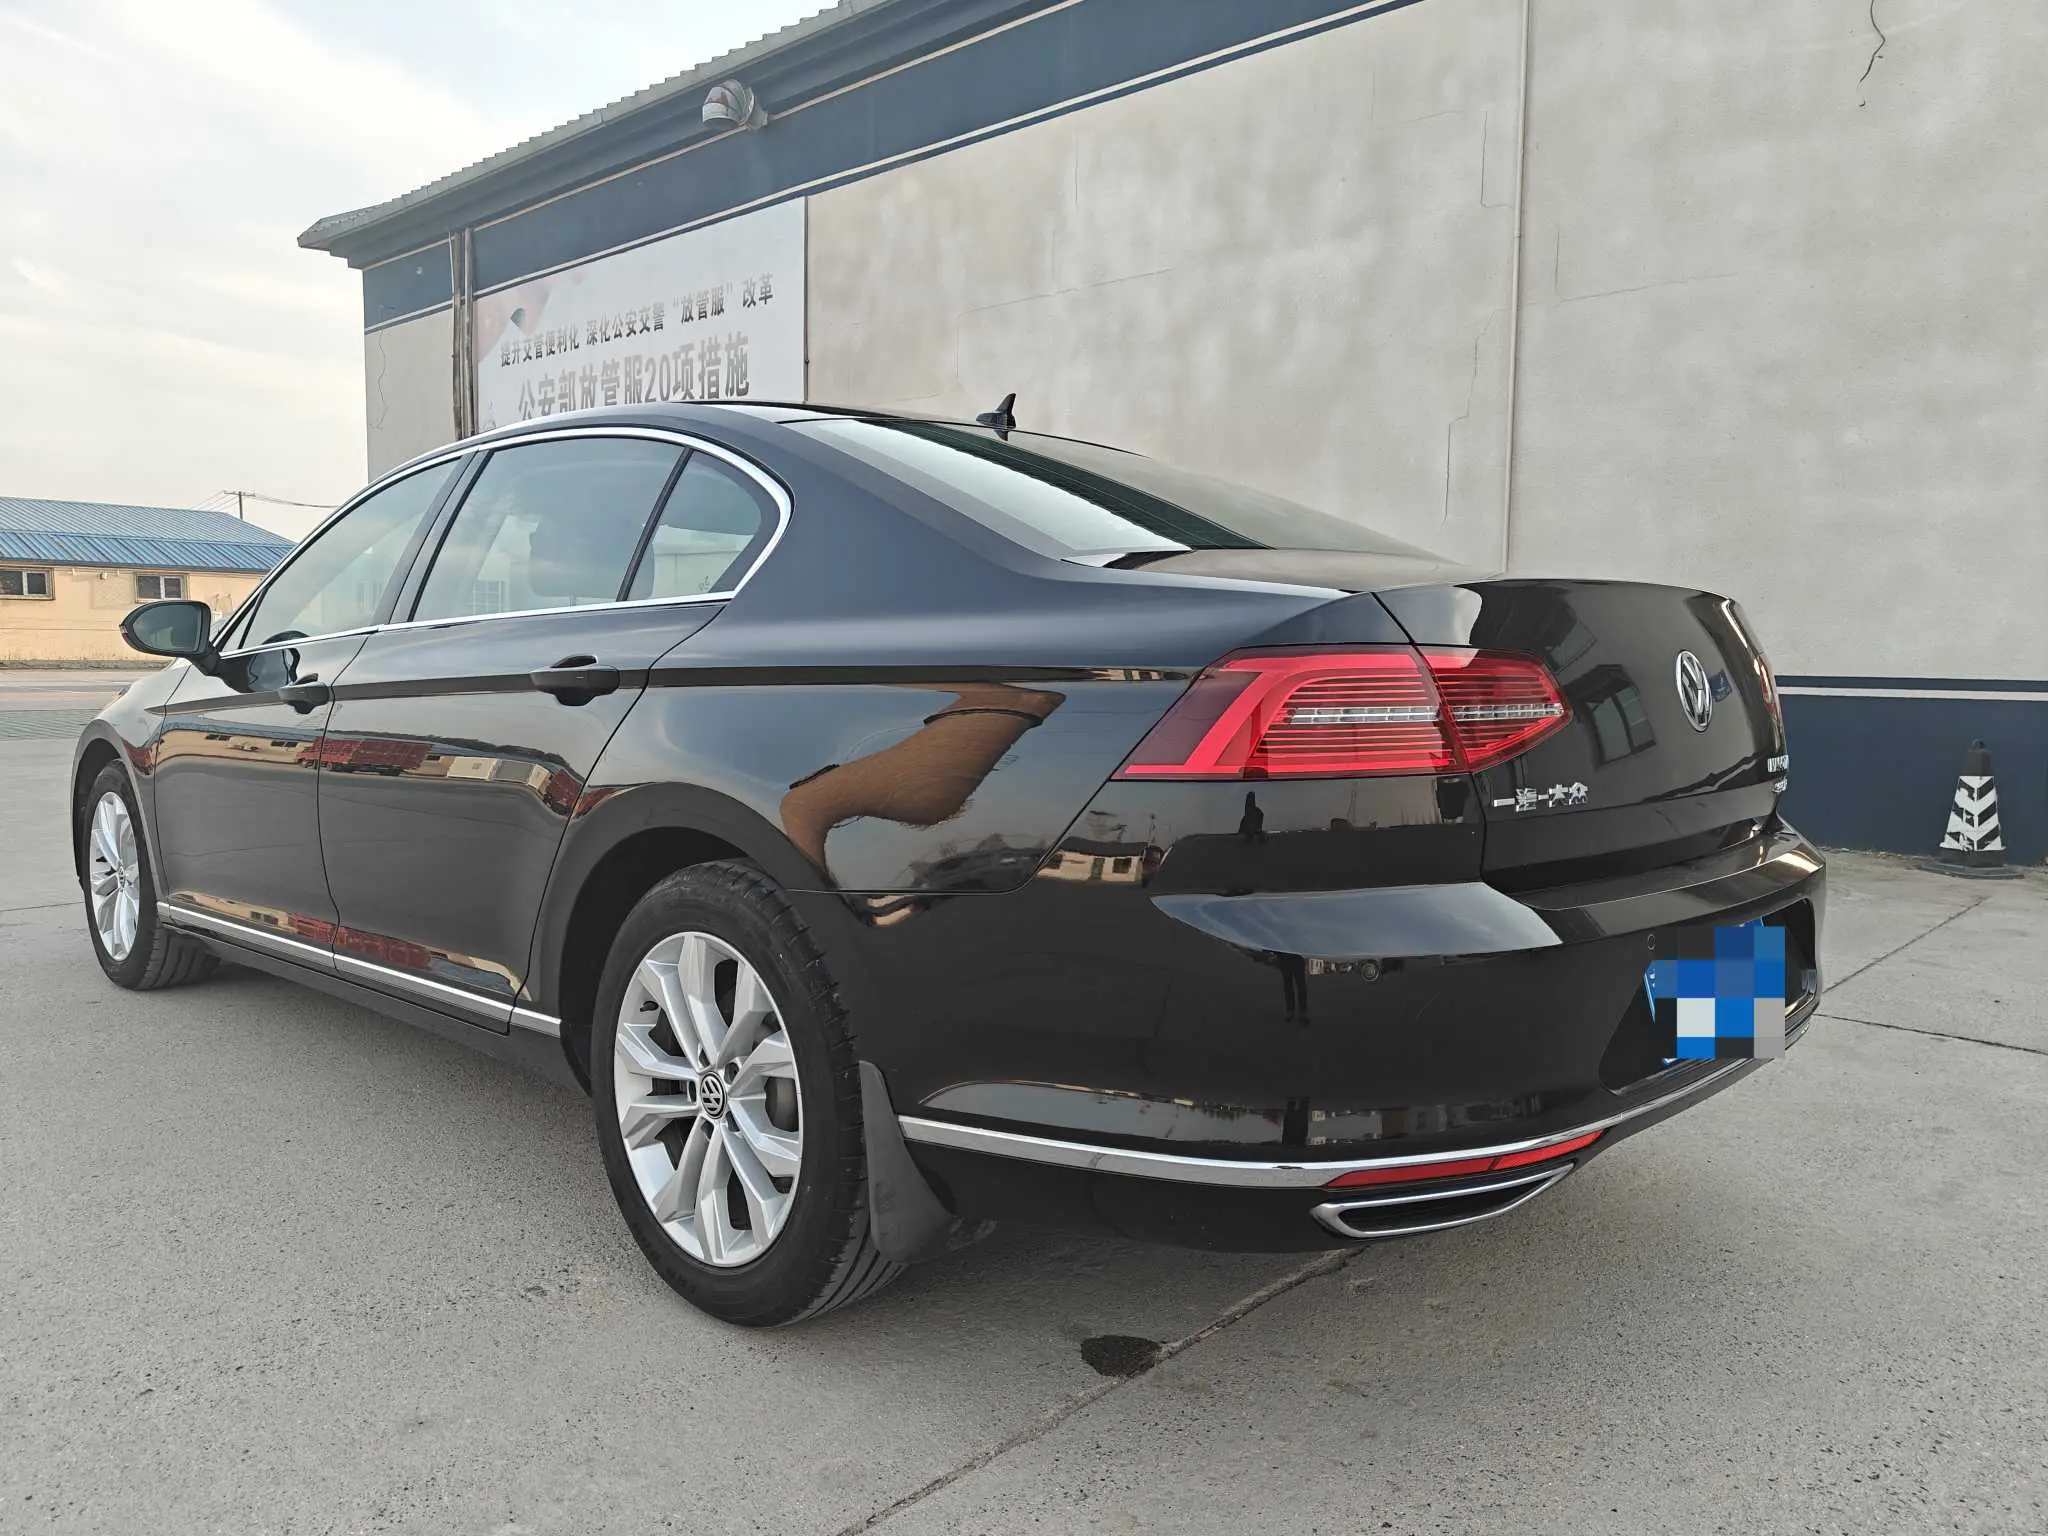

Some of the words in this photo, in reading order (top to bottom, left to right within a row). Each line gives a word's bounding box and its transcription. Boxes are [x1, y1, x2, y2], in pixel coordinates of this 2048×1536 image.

[518, 330, 750, 422] 公安部放管服20项措施
